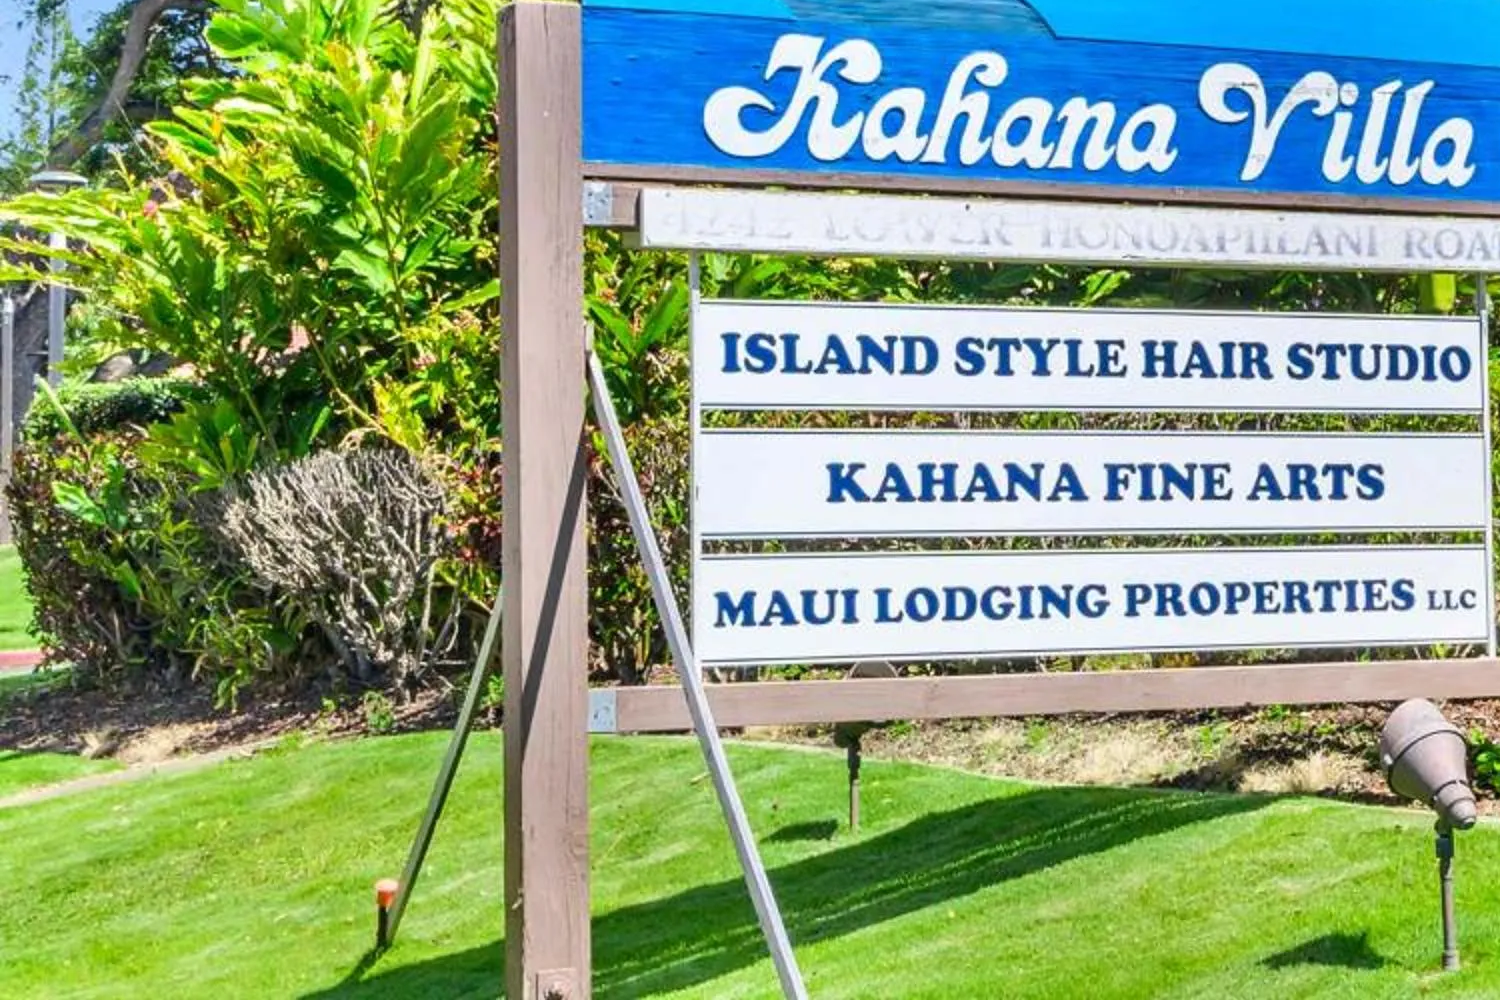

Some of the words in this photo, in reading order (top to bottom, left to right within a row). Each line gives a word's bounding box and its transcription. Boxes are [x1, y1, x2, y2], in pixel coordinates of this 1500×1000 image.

[703, 33, 1177, 172] Kahana
[1199, 63, 1475, 187] Villa
[720, 332, 939, 376] ISLAND
[954, 336, 1128, 378] STYLE
[1141, 339, 1274, 381] HAIR
[1286, 342, 1472, 383] STUDIO
[825, 462, 1089, 503] KAHANA
[1103, 463, 1233, 502] FINE
[1246, 463, 1385, 502] ARTS
[713, 588, 859, 628] MAUI
[873, 584, 1111, 624] LODGING
[1123, 578, 1415, 618] PROPERTIES
[1427, 589, 1476, 611] LLC
